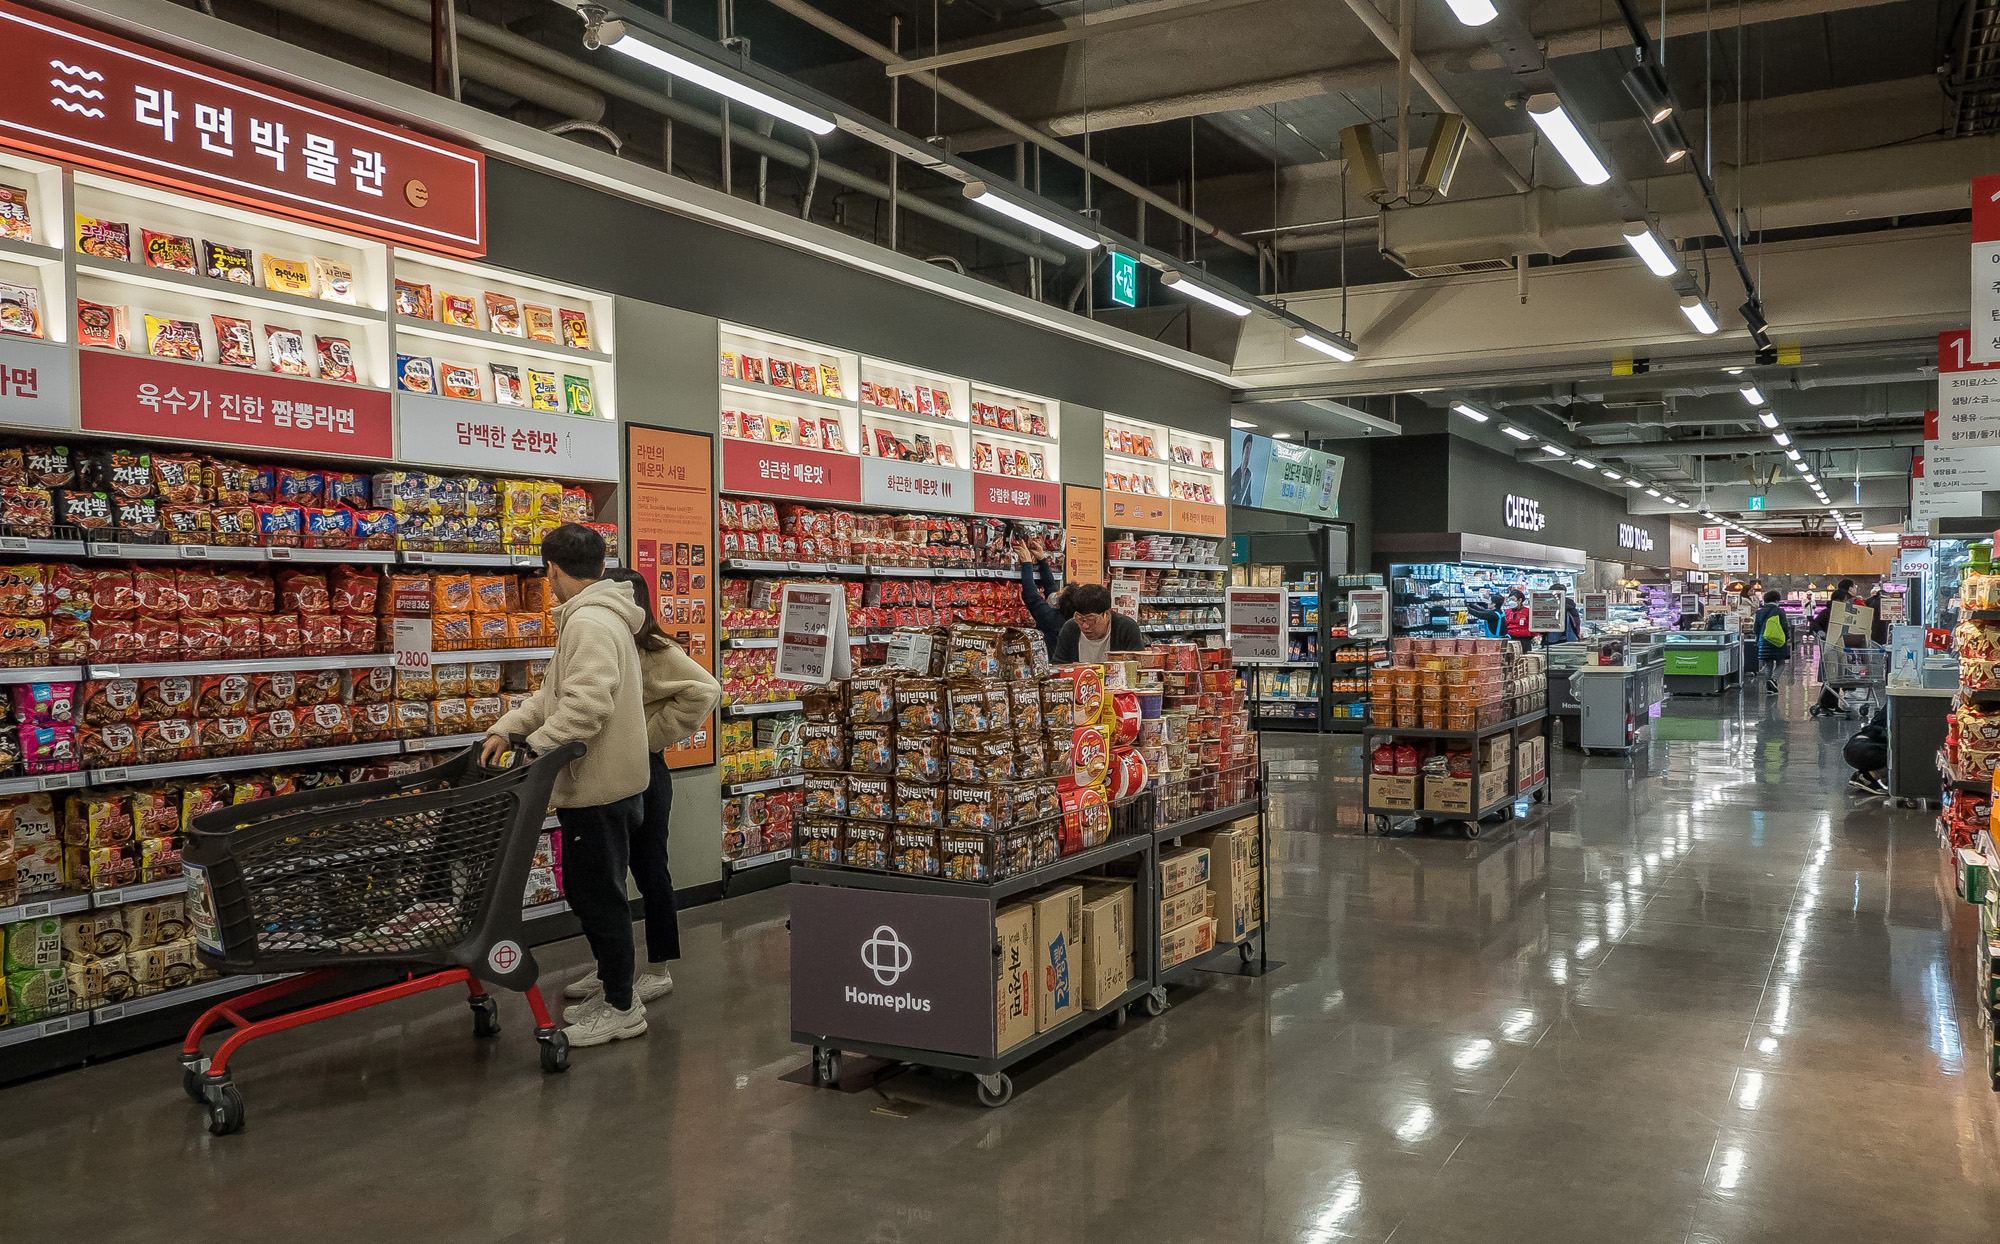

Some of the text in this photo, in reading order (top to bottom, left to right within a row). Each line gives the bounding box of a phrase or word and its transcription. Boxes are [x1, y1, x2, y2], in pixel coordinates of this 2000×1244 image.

[134, 84, 386, 198] 라면박물관
[80, 223, 105, 241] 크림
[275, 267, 307, 283] 라면사리
[326, 268, 351, 280] 사리면
[158, 323, 199, 345] 진짬뽕
[1951, 377, 1998, 388] 조미료/소스
[136, 383, 356, 435] 육수가 진한 짬뽕라면
[1951, 395, 1989, 405] 설탕/소금
[1951, 413, 1977, 422] 식용유
[456, 422, 558, 455] 담백한 순한맛
[637, 444, 665, 461] 라면의
[28, 454, 69, 474] 짬뽕
[637, 462, 686, 481] 매운맛 서열
[758, 459, 824, 485] 얼큰한 매운맛
[112, 466, 149, 485] 짬뽕
[1933, 480, 1960, 488] 햄/소시지
[887, 475, 938, 498] 화끈한 매운맛
[989, 487, 1031, 506] 강렬한 매운맛
[67, 498, 108, 517] 짬뽕
[119, 504, 156, 523] 짬뽕
[1506, 493, 1539, 532] CHEESE
[1620, 523, 1634, 548] FOOD
[1254, 616, 1277, 625] 1,460
[2, 627, 41, 641] 너구리
[1928, 632, 1947, 645] 1+1
[396, 650, 429, 668] 2,800
[1254, 648, 1277, 657] 1,460
[801, 663, 822, 675] 1,990
[37, 940, 58, 951] 사리
[37, 953, 48, 964] 면
[48, 983, 68, 996] 사리
[1008, 946, 1022, 1020] 짜장면
[845, 985, 932, 1013] Homeplus
